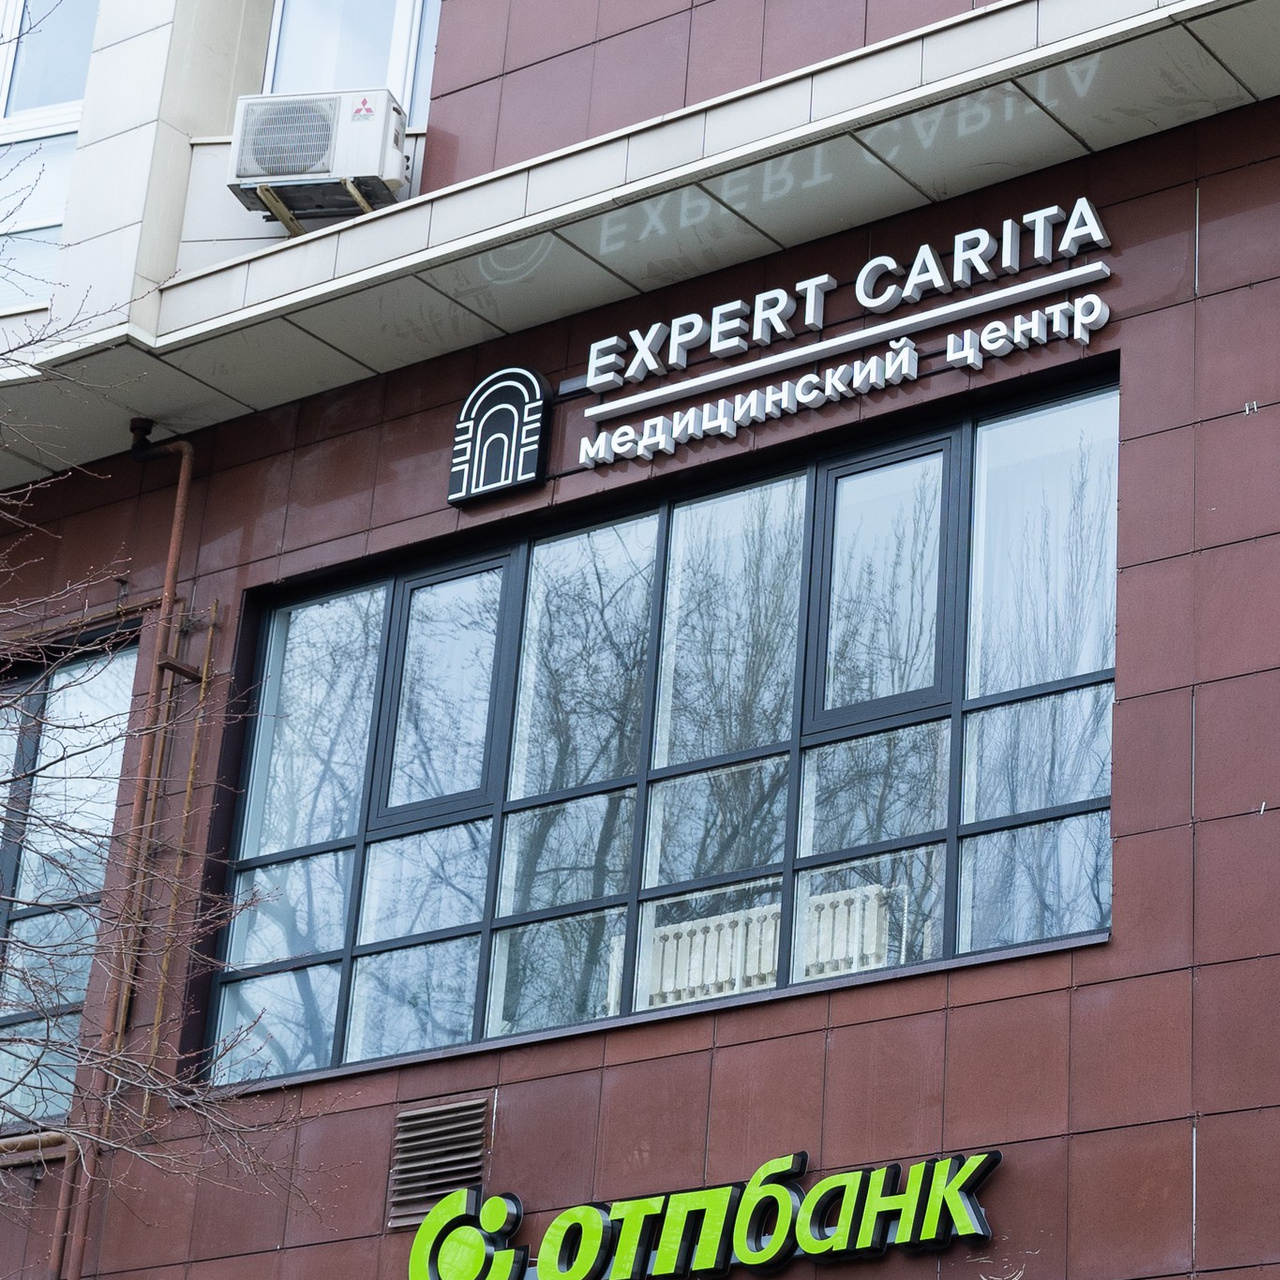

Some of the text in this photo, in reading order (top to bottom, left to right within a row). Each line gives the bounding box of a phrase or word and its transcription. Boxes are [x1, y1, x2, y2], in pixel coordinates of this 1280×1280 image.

[579, 292, 1110, 470] медицинский центр
[586, 197, 1112, 393] EXPERT CARITA
